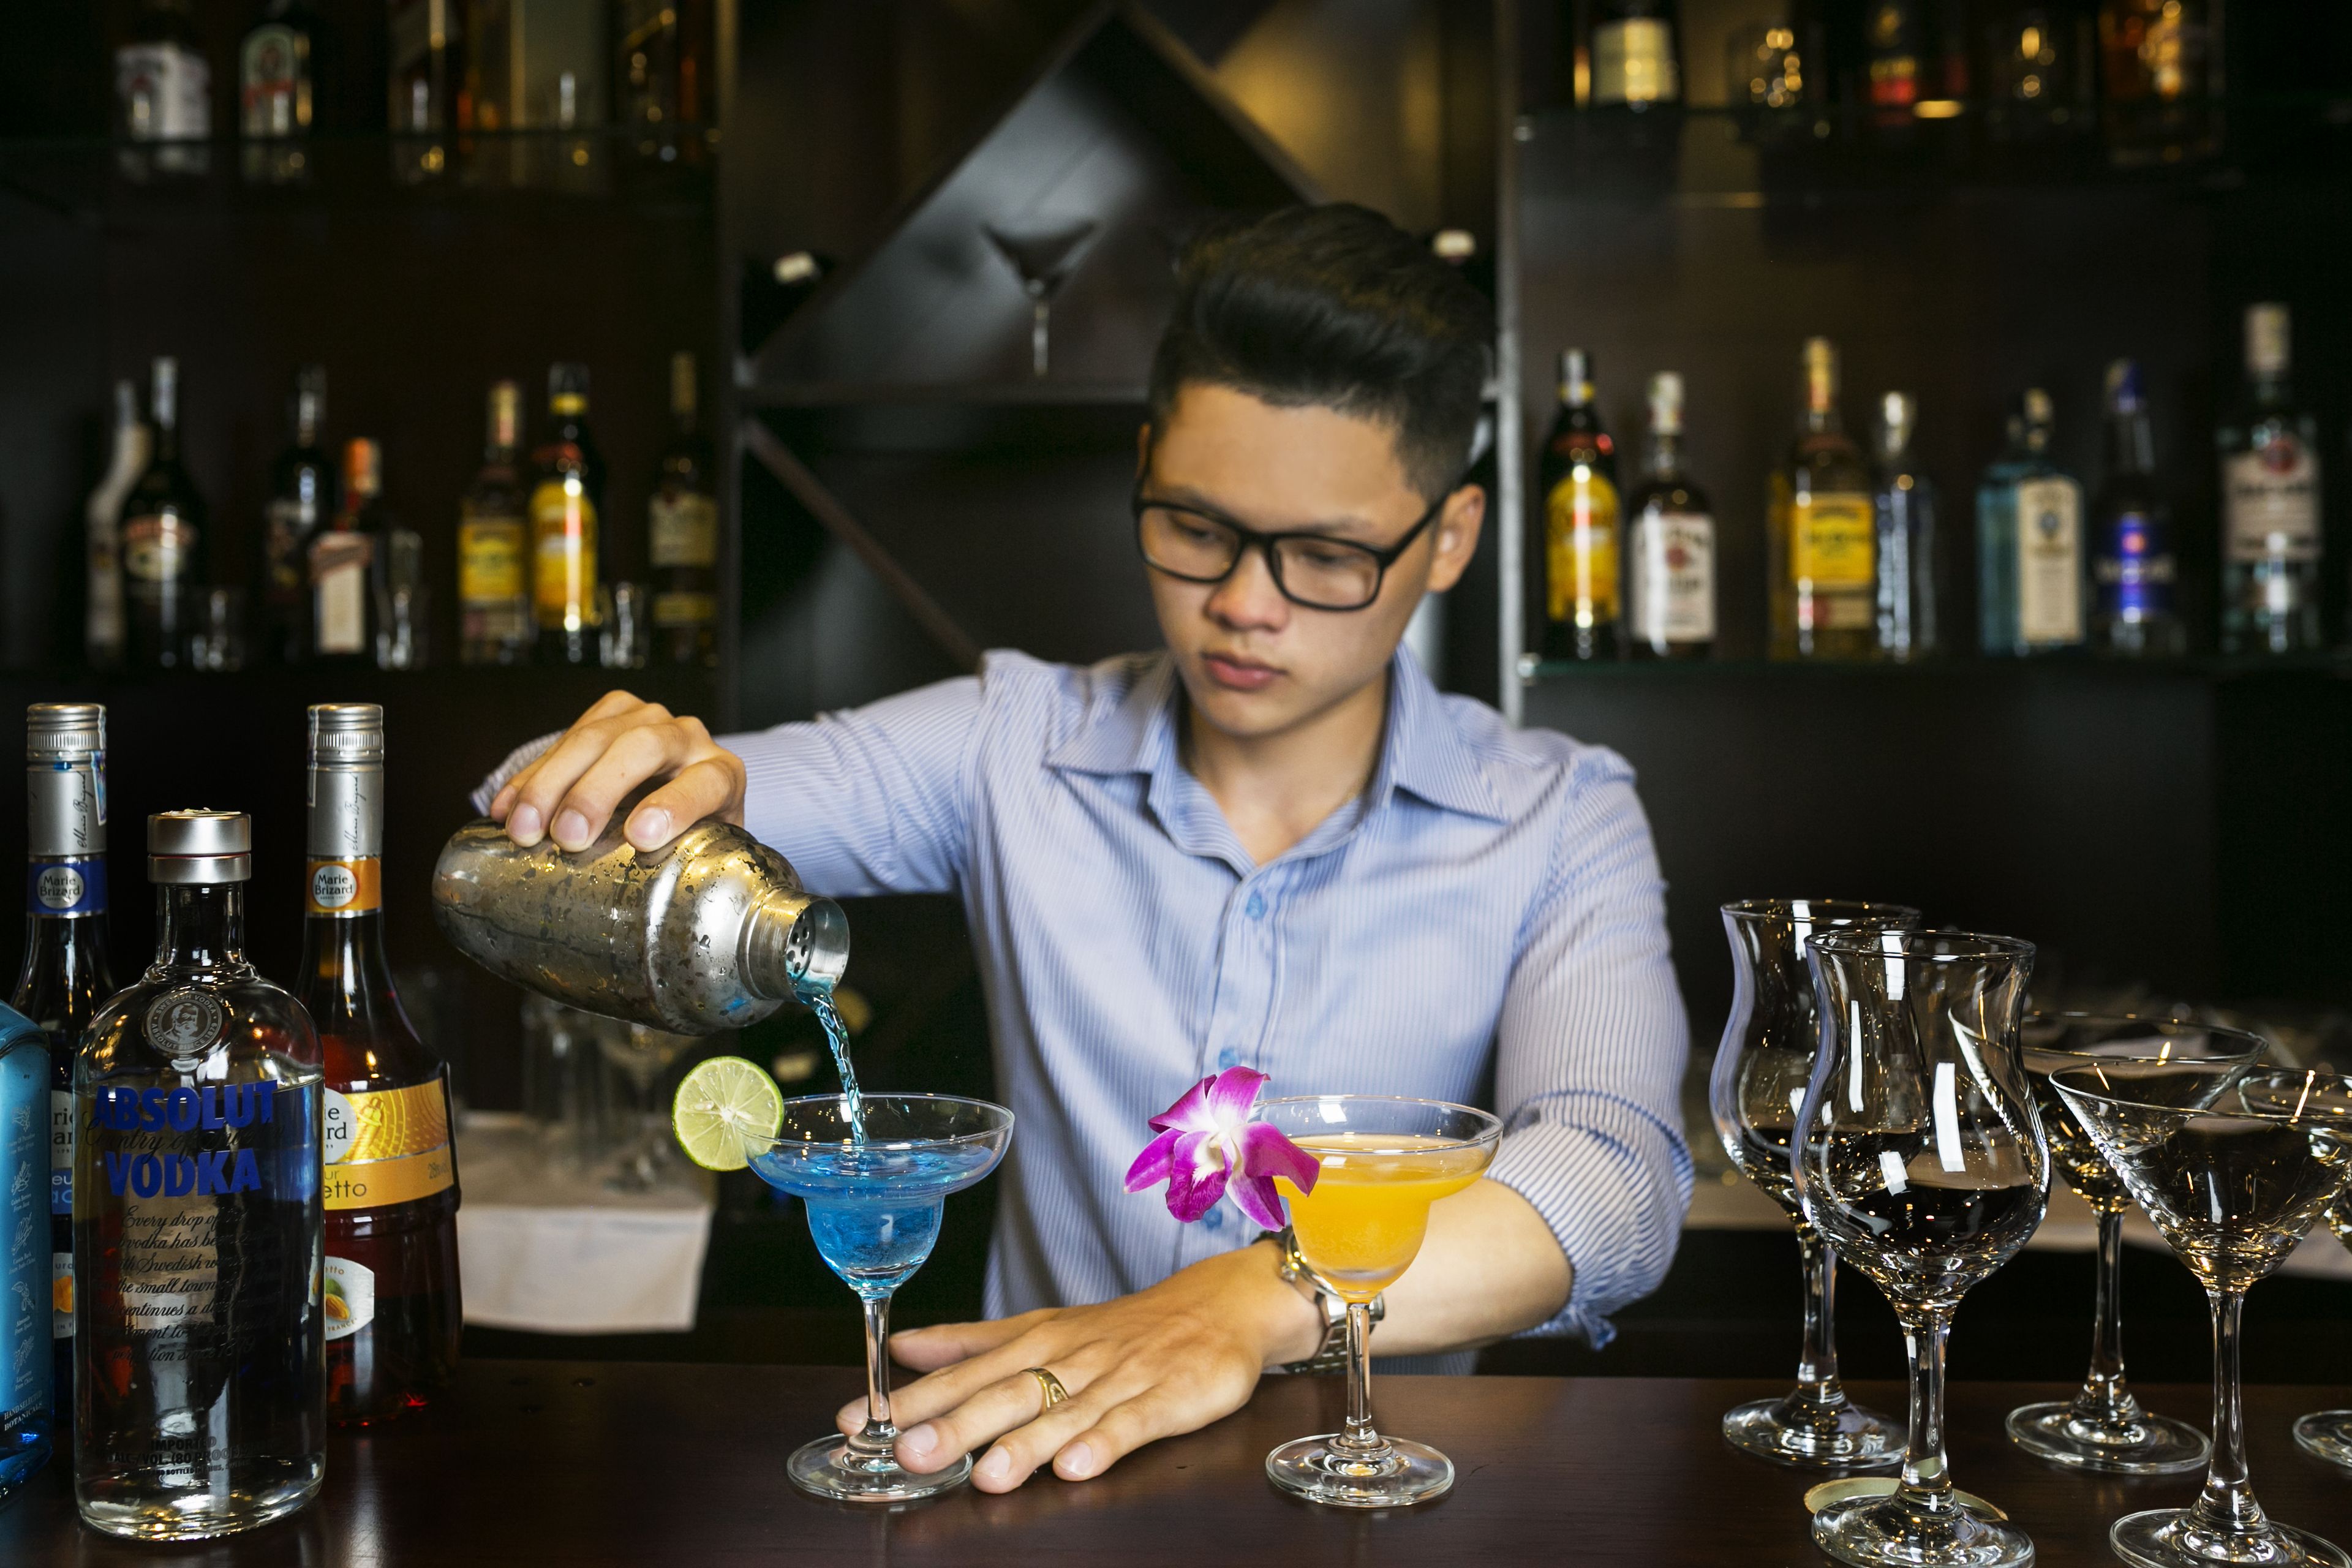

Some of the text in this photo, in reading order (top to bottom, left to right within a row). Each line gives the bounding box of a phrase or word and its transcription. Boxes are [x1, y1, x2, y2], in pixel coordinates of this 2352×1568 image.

[43, 876, 76, 886] Marie
[318, 874, 348, 884] Marie
[40, 886, 80, 897] Brizard
[315, 884, 352, 895] Brizard
[156, 994, 216, 1014] SWEDISH VODKA
[151, 1023, 177, 1049] ABSOLUT
[206, 1023, 217, 1038] 1879
[94, 1080, 277, 1132] ABSOLUT
[105, 1147, 262, 1198] VODKA
[124, 1205, 167, 1235] Every
[170, 1210, 203, 1231] drop
[127, 1230, 169, 1250] vodka
[169, 1232, 198, 1250] has
[138, 1252, 202, 1276] Swedish
[135, 1277, 181, 1294] small
[179, 1280, 216, 1294] town
[187, 1305, 197, 1316] a
[4, 1404, 20, 1420] HAND
[151, 1436, 217, 1452] IMPORTED
